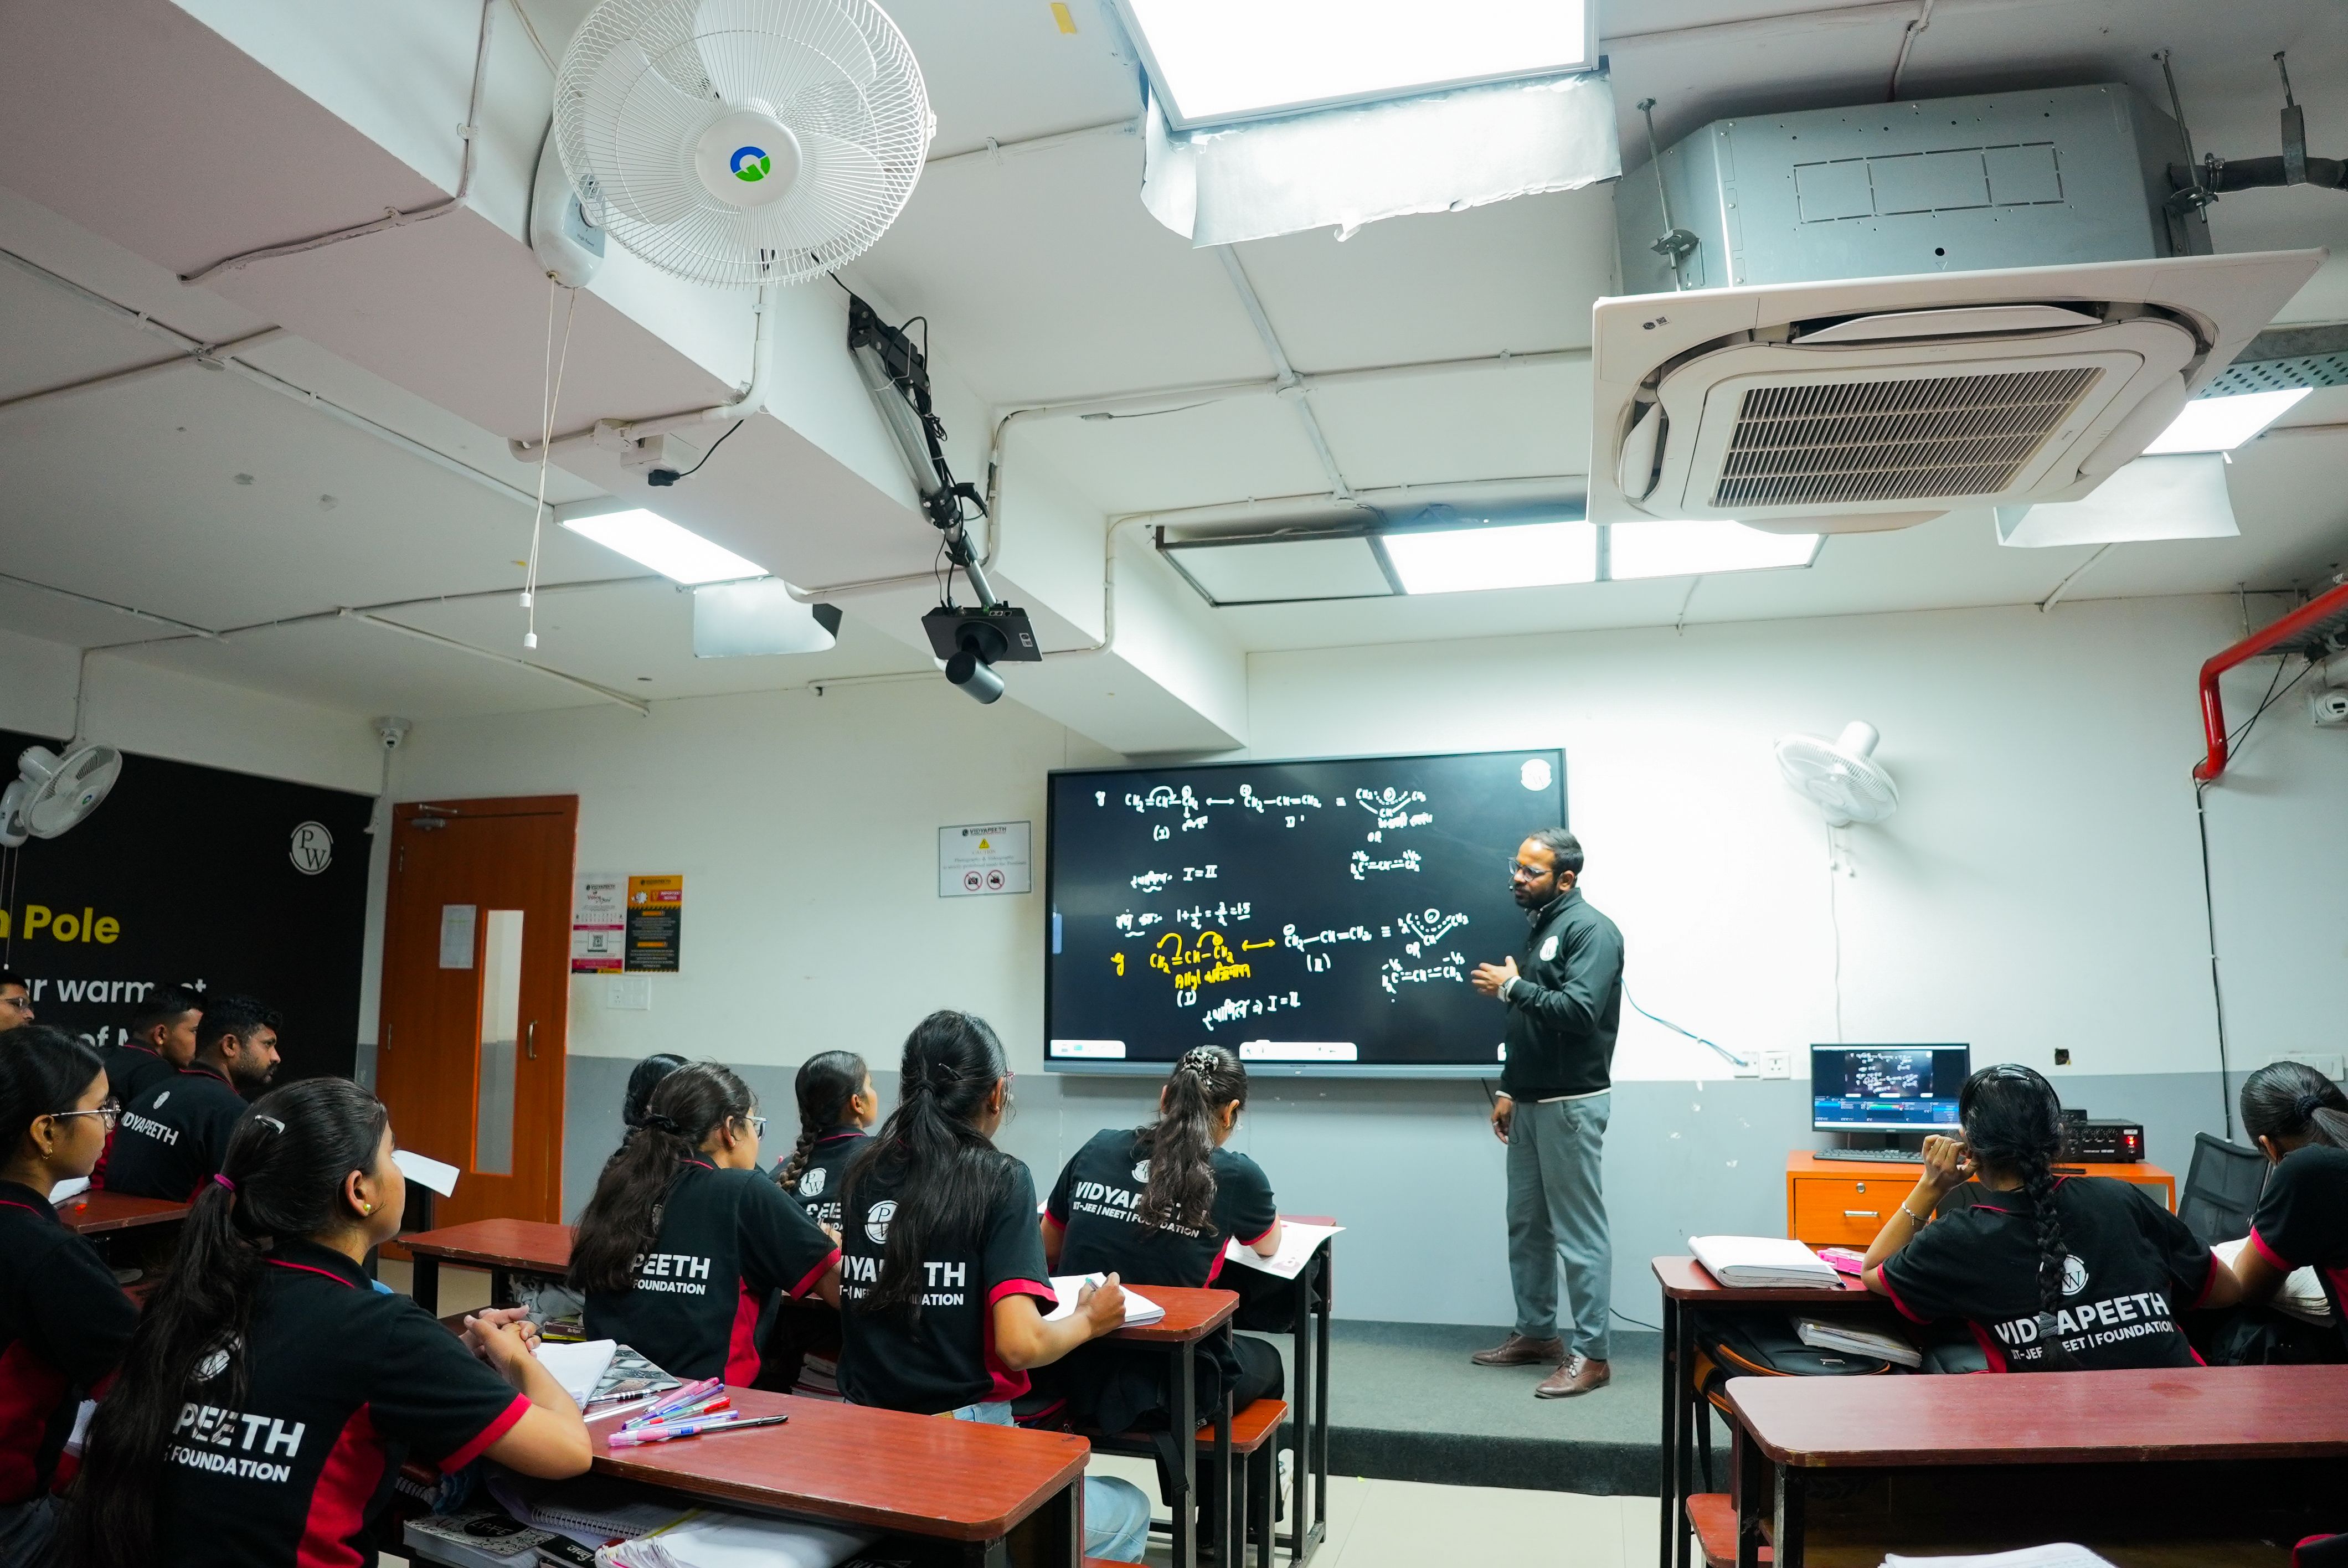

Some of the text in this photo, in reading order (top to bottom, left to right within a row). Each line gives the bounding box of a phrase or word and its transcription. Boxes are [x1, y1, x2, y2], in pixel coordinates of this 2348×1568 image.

[24, 904, 120, 943] Pole
[1101, 1206, 1127, 1220] NEET
[1994, 1292, 2170, 1344] VIDAPEETH
[2062, 1336, 2085, 1353] EET
[171, 1446, 291, 1483] FOUNDATION
